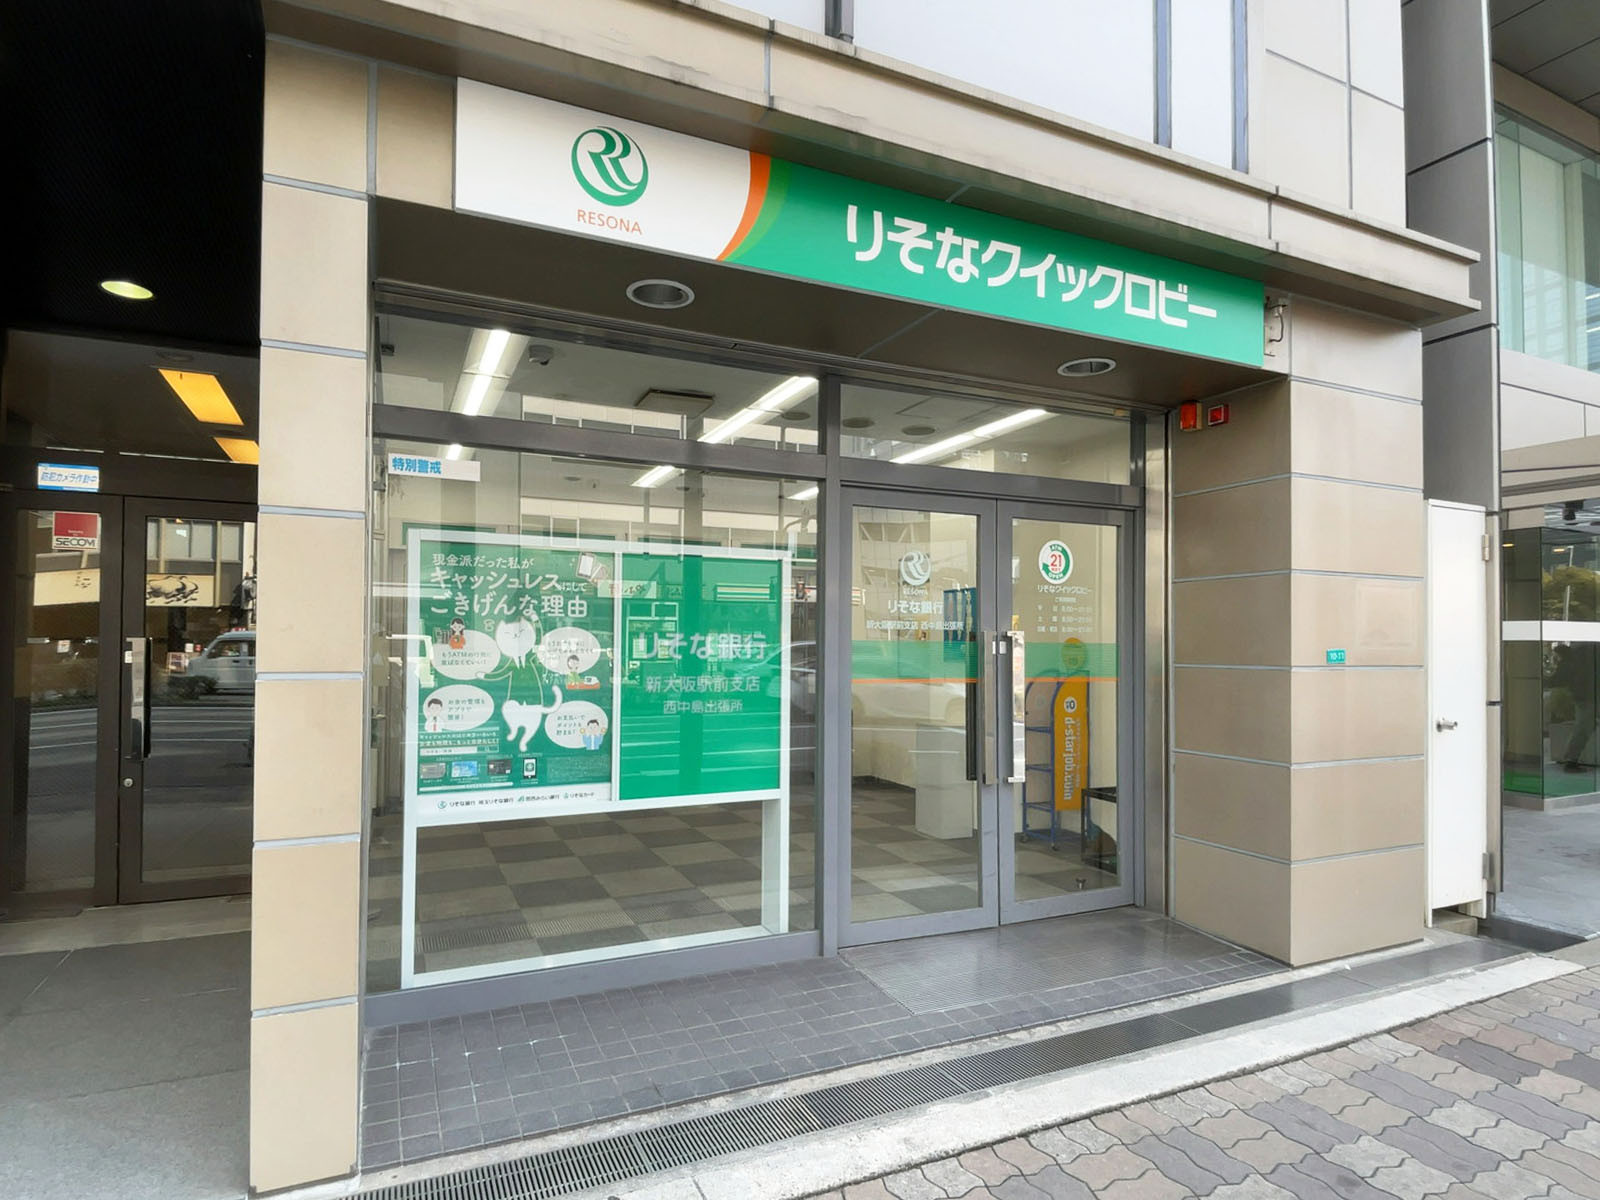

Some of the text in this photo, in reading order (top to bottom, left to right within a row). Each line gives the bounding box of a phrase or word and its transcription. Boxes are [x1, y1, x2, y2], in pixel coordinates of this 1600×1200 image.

[577, 208, 643, 235] RESONA
[846, 204, 1218, 328] りそなクイックロビー
[392, 457, 442, 474] 特別警戒
[55, 537, 95, 547] SECOM
[432, 553, 534, 569] 現金派だった私が
[1050, 553, 1062, 567] 21
[431, 591, 588, 618] ごきげんな理由
[888, 600, 944, 614] りそな銀行
[638, 632, 767, 660] りそな銀行
[646, 675, 760, 693] 新大阪駅前支店
[664, 700, 743, 714] 西中島出張所
